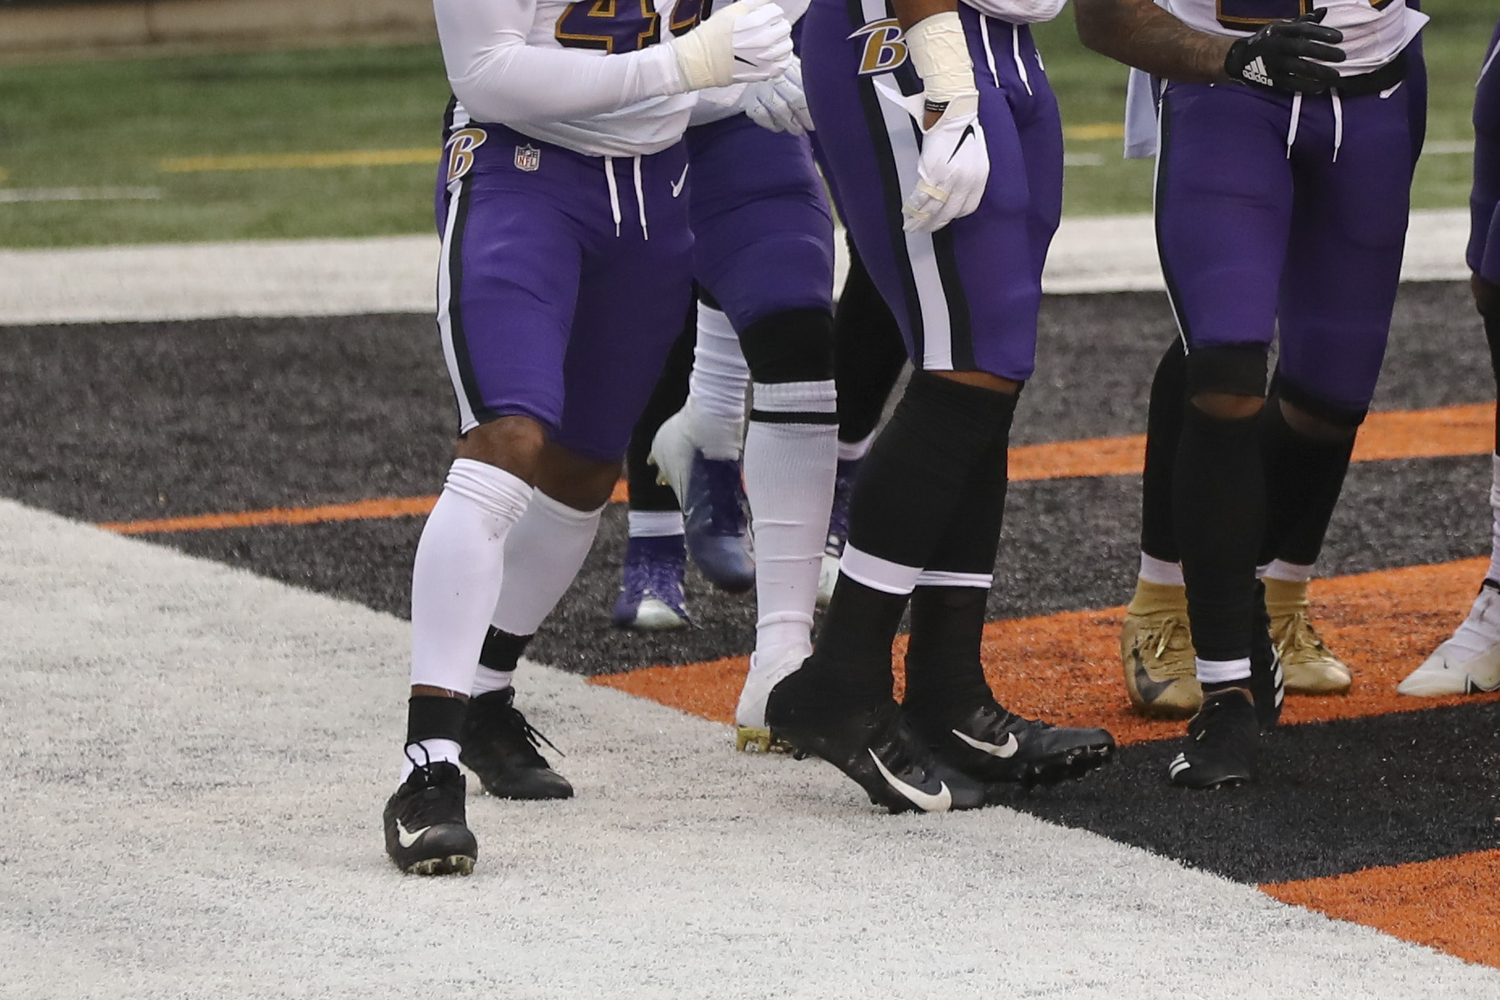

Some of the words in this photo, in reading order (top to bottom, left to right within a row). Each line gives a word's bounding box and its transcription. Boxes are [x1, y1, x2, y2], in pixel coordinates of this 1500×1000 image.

[846, 17, 909, 76] B
[1242, 68, 1274, 87] adidas
[445, 127, 488, 183] B
[516, 156, 538, 169] NFL
